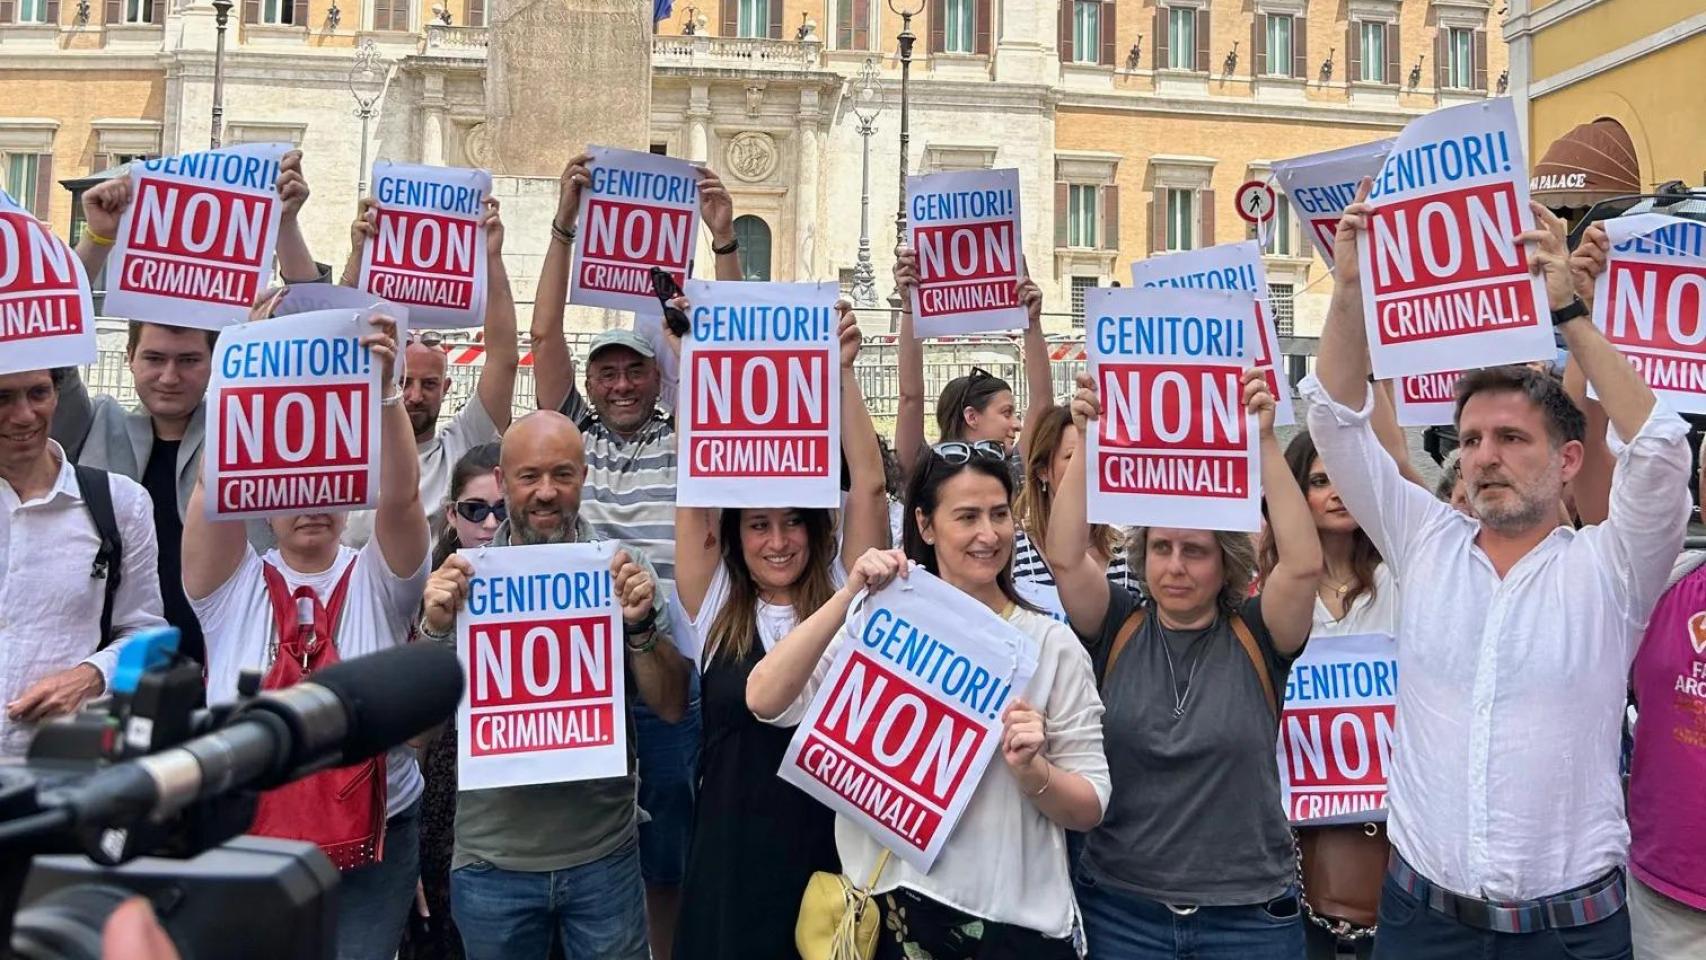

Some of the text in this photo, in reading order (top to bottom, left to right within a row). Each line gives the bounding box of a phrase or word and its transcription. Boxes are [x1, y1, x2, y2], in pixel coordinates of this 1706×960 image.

[379, 177, 481, 215] GENITORI!
[592, 167, 697, 204] GENITORI!
[1539, 173, 1586, 190] PALACE
[135, 185, 265, 260] NON
[913, 189, 1013, 221] GENITORI!
[377, 214, 472, 272] NON
[588, 205, 687, 263] NON
[918, 225, 1012, 279] NON
[1373, 191, 1519, 287] NON
[127, 258, 249, 303] CRIMINALI.
[371, 273, 466, 306] CRIMINALI.
[922, 283, 1015, 313] CRIMINALI.
[693, 306, 829, 342] GENITORI!
[1383, 287, 1530, 338] CRIMINALI.
[222, 337, 370, 379] GENITORI!
[1097, 316, 1244, 358] GENITORI!
[697, 356, 823, 425] NON
[1105, 371, 1241, 444] NON
[226, 391, 362, 465] NON
[695, 440, 823, 473] CRIMINALI.
[1104, 456, 1242, 494] CRIMINALI.
[224, 474, 361, 510] CRIMINALI.
[469, 570, 611, 616] GENITORI!
[476, 623, 606, 701] NON
[862, 608, 1012, 720] GENITORI!
[476, 708, 609, 751] CRIMINALI.
[823, 660, 977, 800] NON
[803, 742, 929, 845] CRIMINALI.
